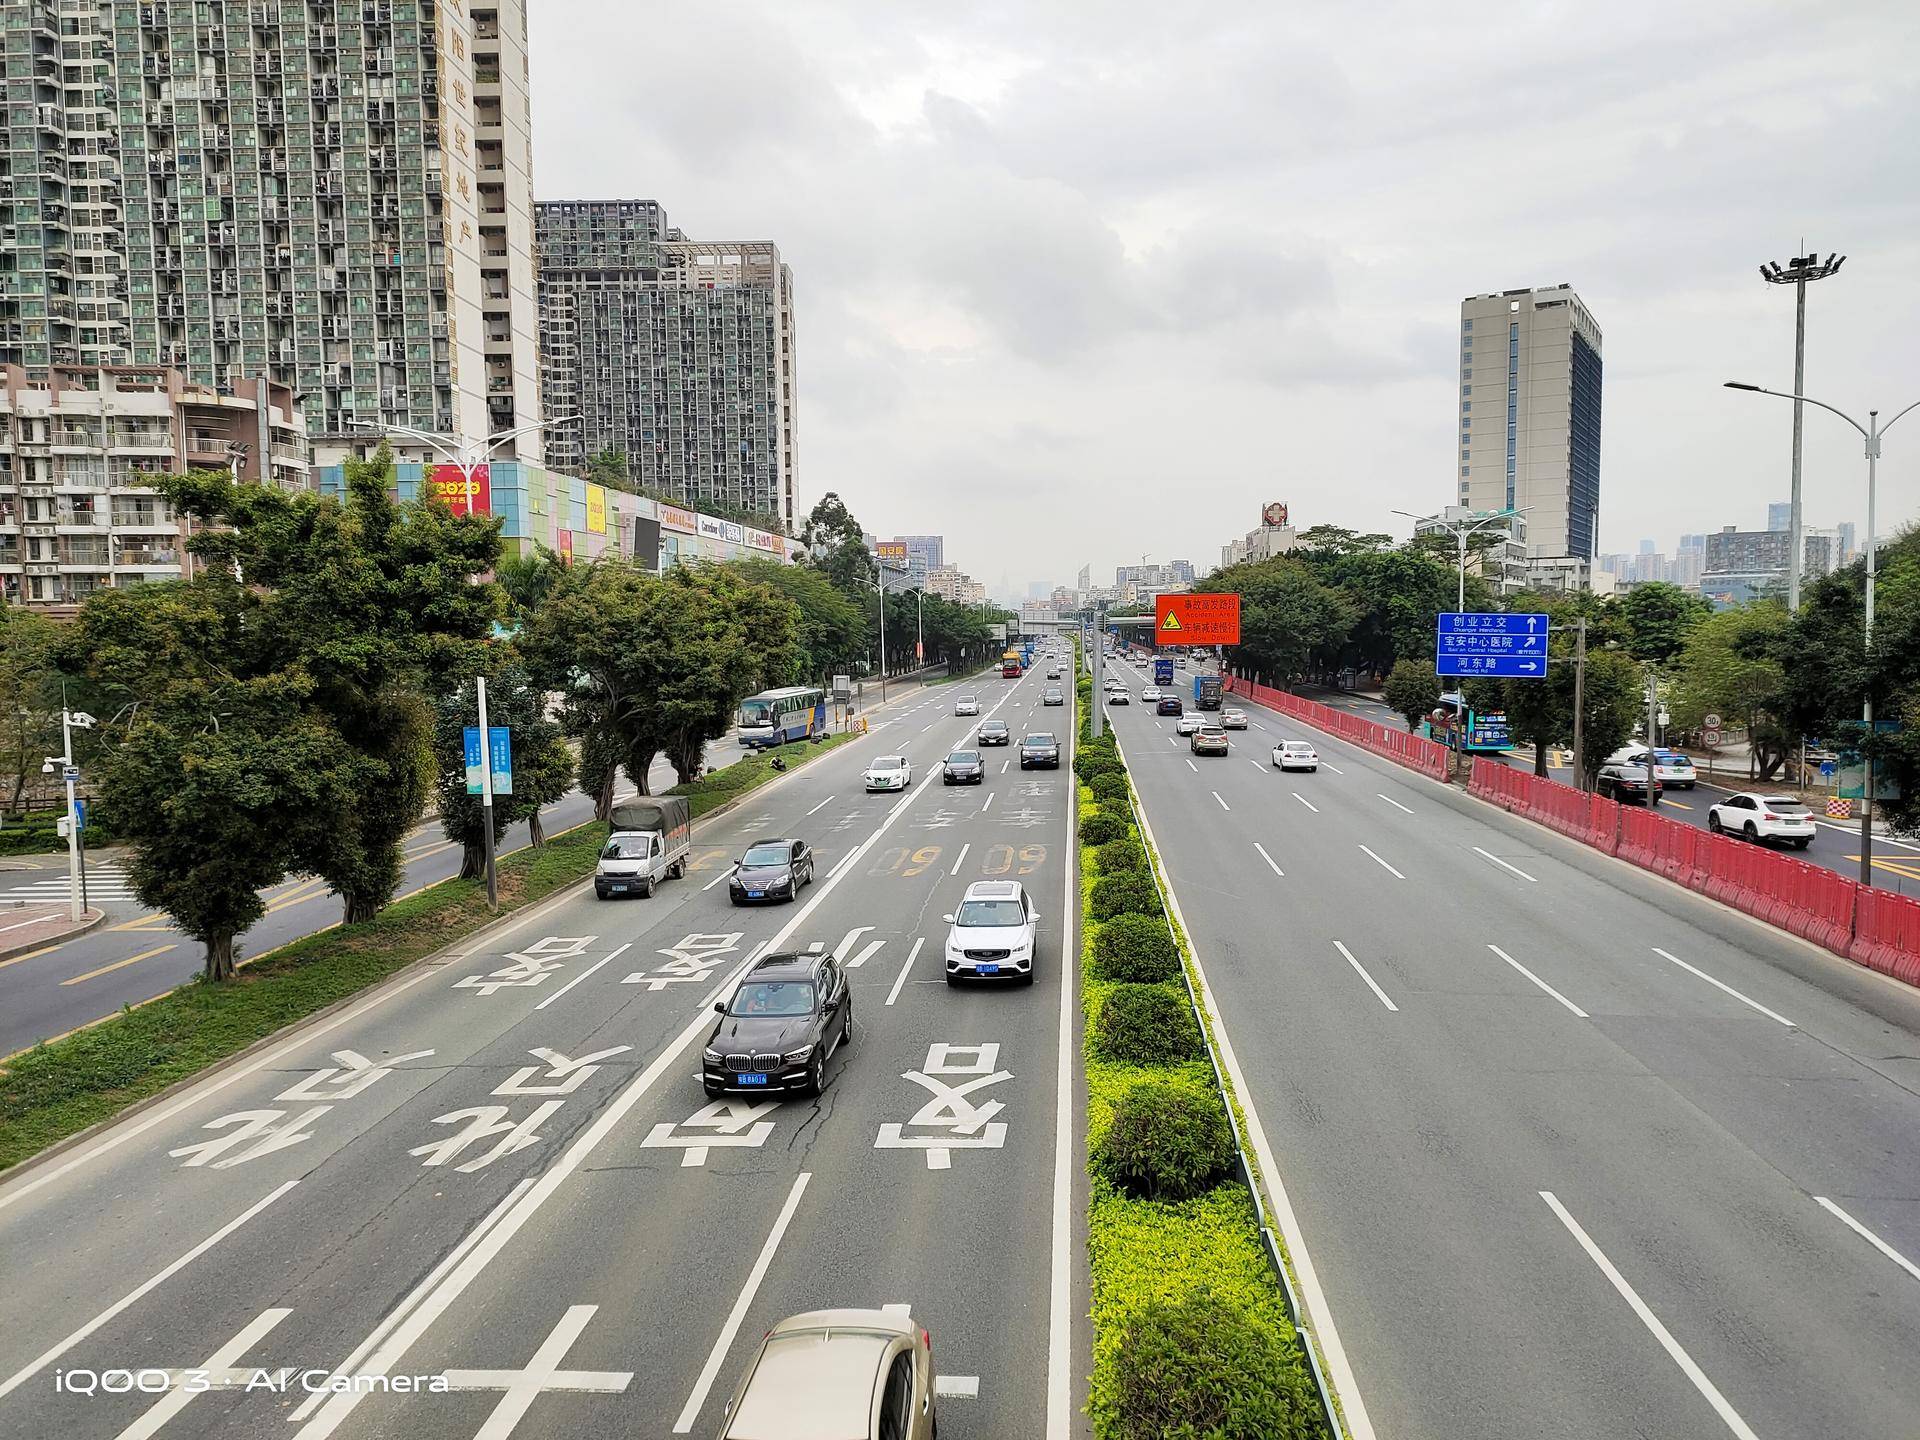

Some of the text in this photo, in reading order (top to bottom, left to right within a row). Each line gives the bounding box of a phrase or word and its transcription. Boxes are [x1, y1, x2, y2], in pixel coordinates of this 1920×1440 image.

[1453, 616, 1507, 628] 创业立交
[1444, 636, 1513, 648] 宝安中心医院
[1457, 657, 1497, 669] 河东路
